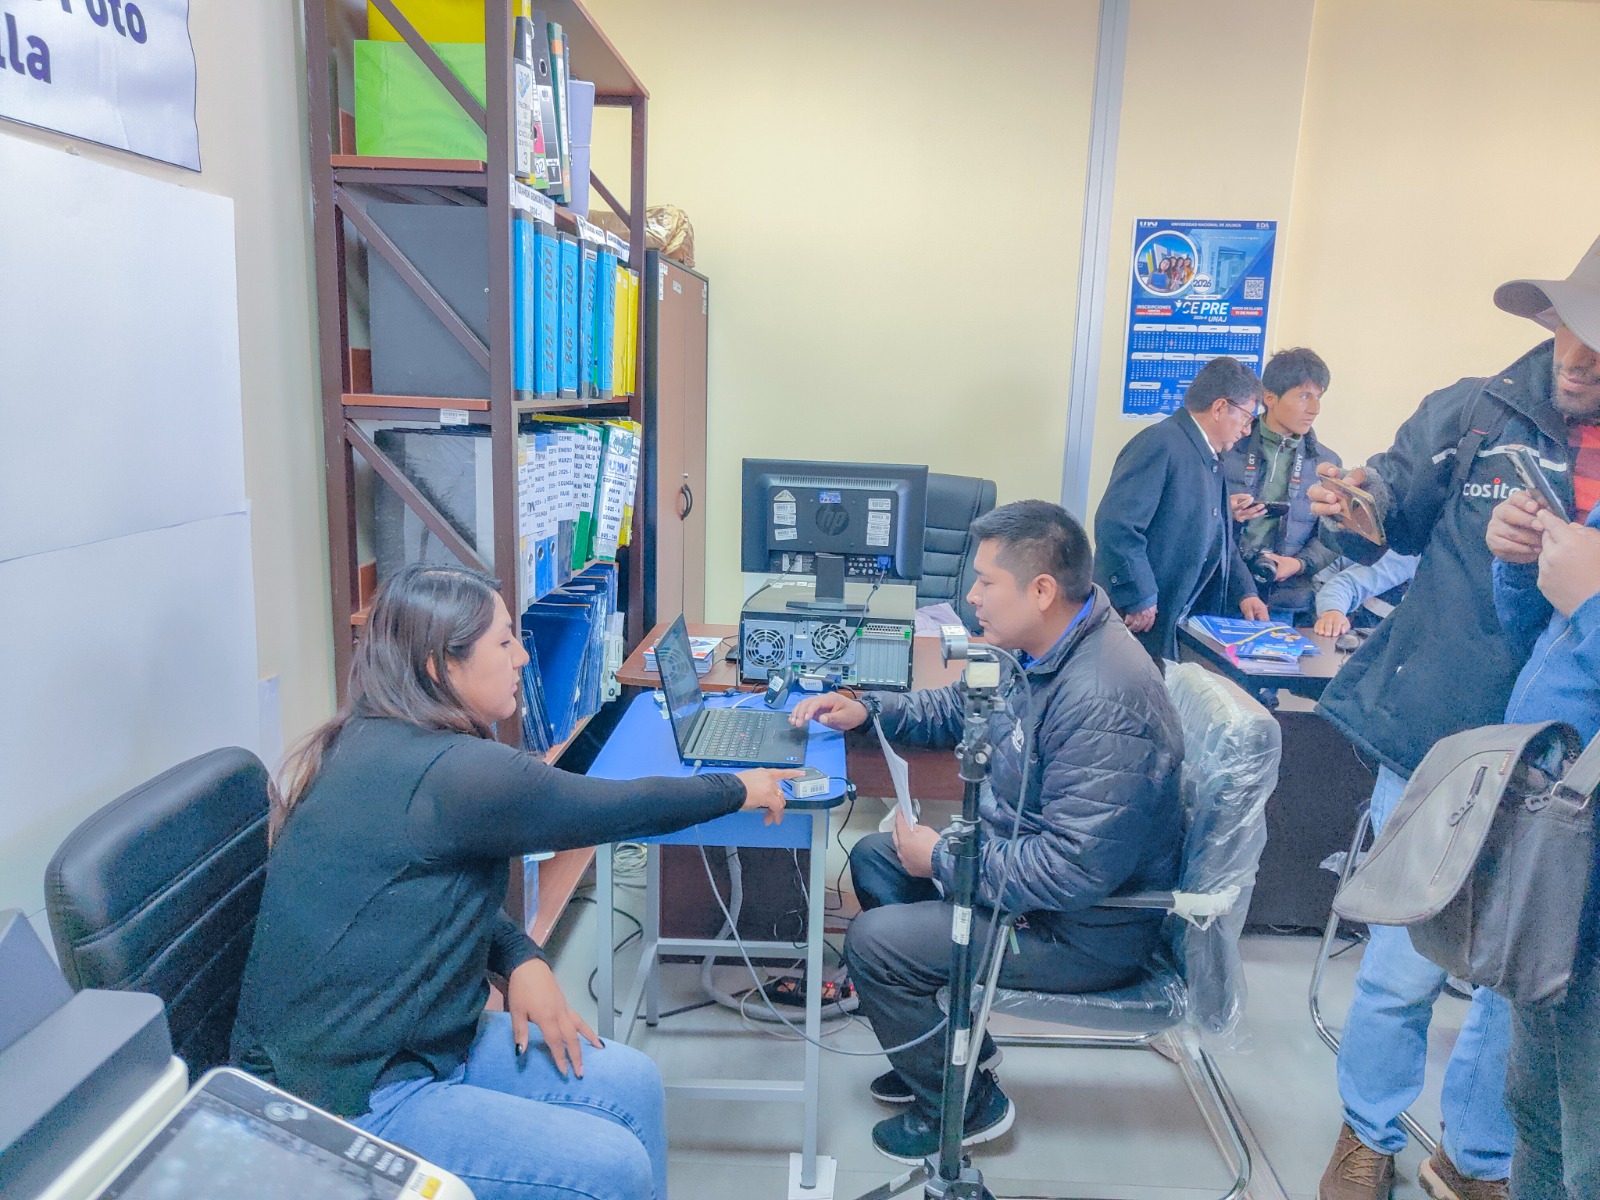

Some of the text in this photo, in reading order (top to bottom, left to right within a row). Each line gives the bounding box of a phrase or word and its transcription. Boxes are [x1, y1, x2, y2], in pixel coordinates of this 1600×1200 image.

[60, 0, 148, 45] oto
[0, 12, 52, 84] la
[544, 246, 554, 302] 1001
[565, 264, 574, 305] 001
[1193, 279, 1212, 288] 2026
[1294, 454, 1303, 478] SONY
